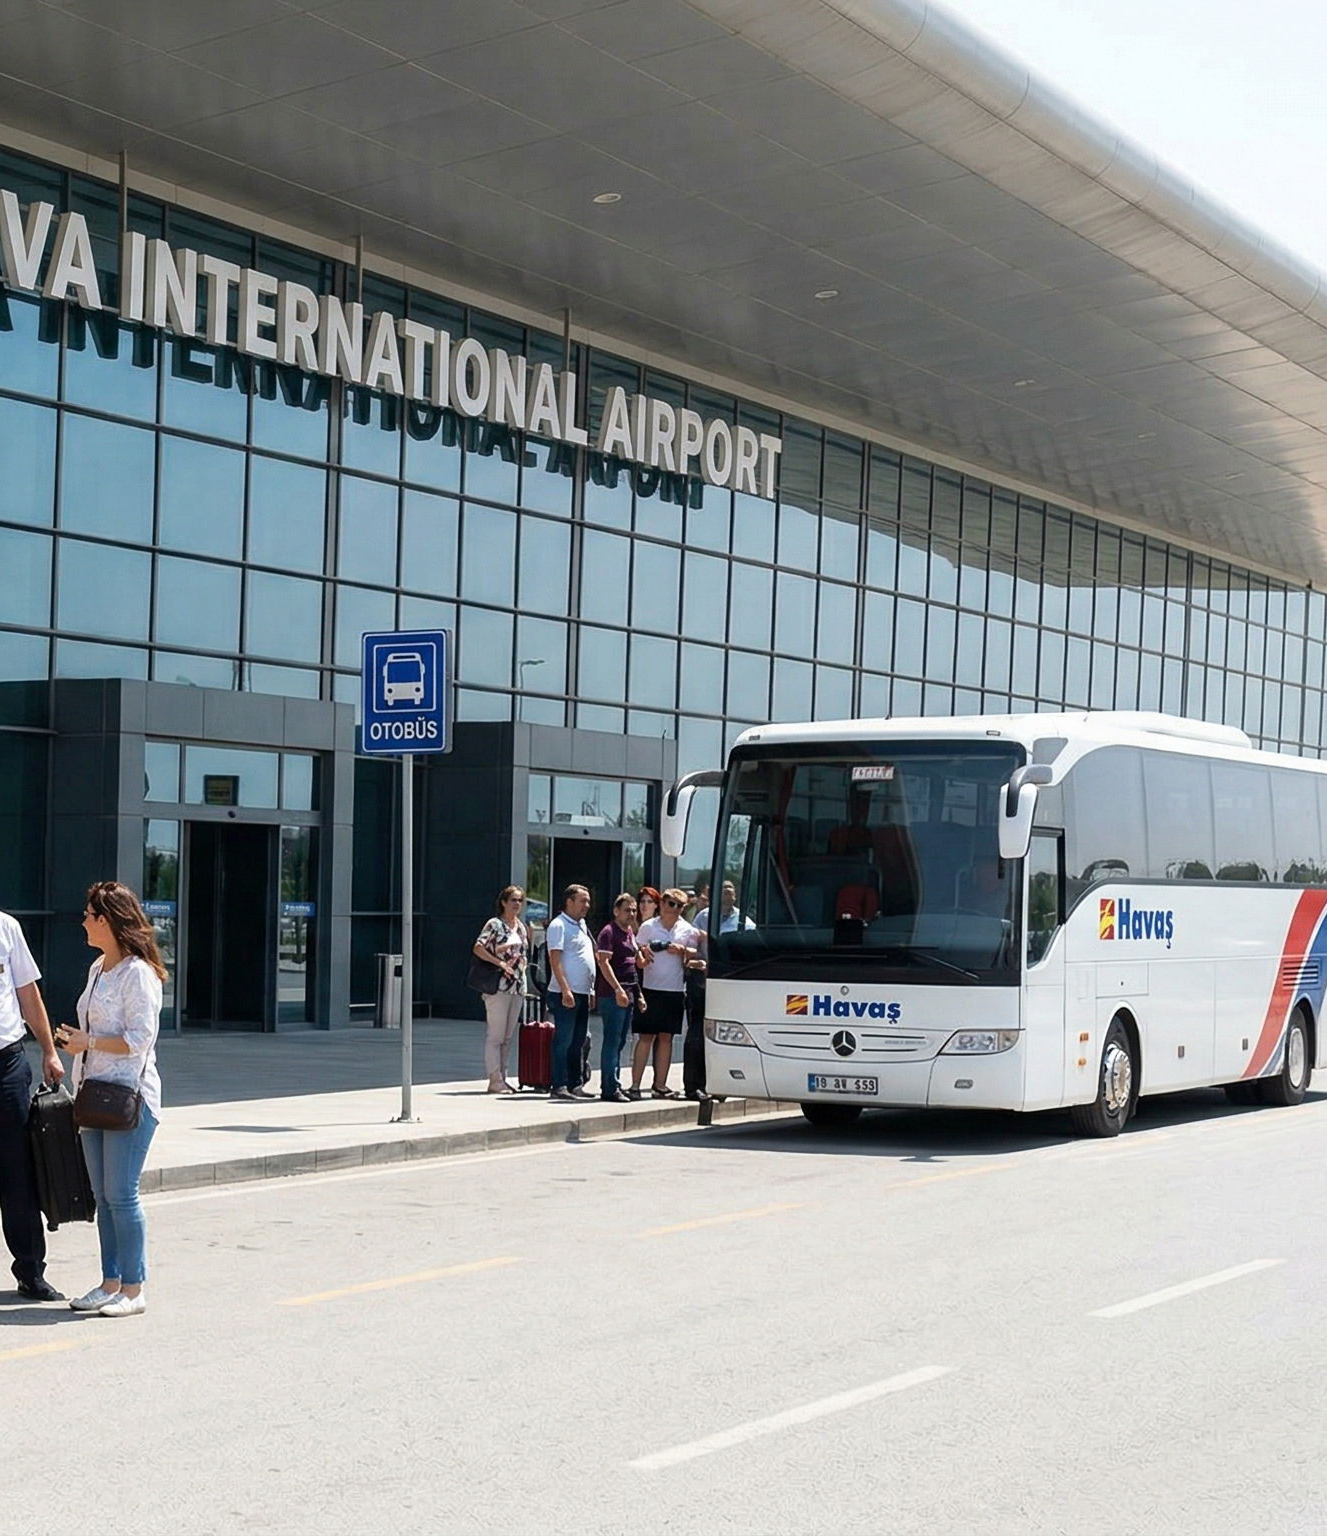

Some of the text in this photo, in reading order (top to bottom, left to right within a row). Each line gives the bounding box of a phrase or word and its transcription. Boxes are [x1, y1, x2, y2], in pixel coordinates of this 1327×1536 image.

[121, 229, 589, 447] INTERNATIONAL
[598, 385, 782, 500] AIRPORT
[1117, 898, 1174, 949] Havaş
[813, 995, 901, 1024] Havaş
